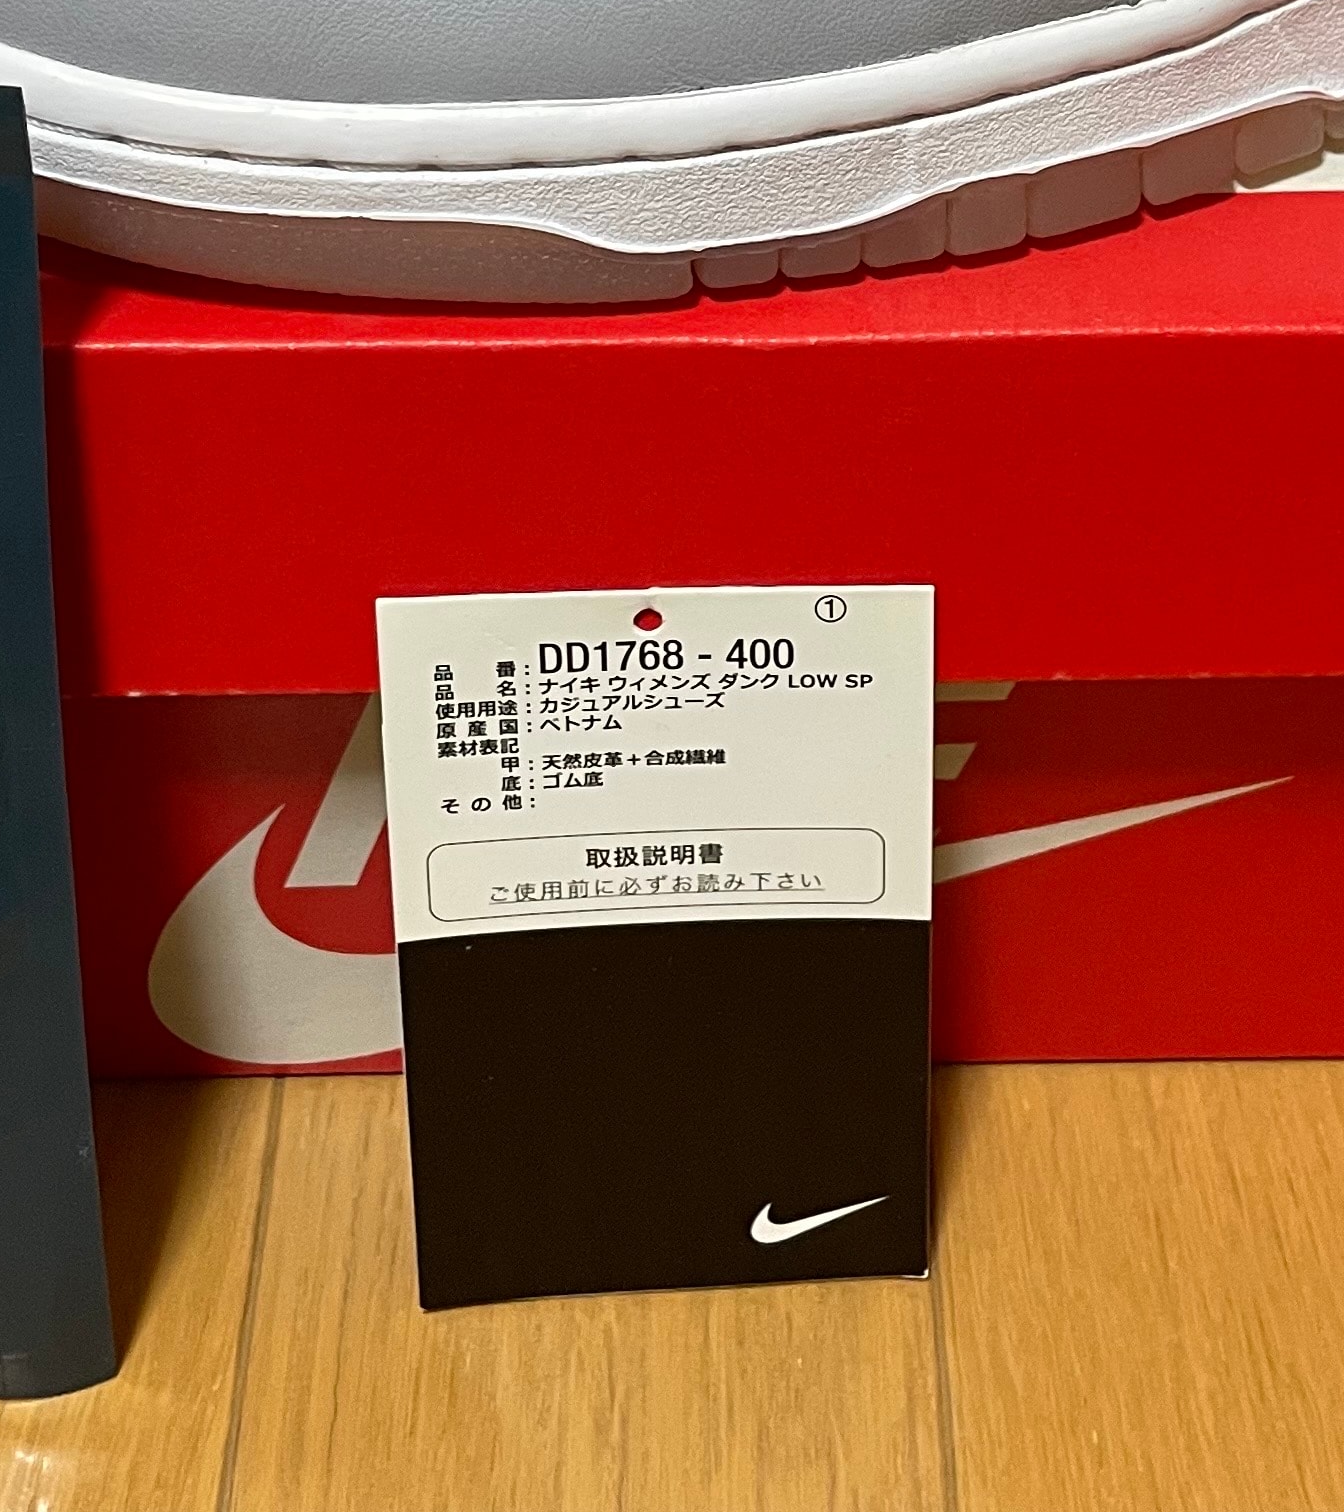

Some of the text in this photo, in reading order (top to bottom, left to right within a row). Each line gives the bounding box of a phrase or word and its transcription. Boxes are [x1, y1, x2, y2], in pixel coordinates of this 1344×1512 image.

[539, 639, 684, 674] DD1768
[725, 638, 795, 669] 400
[538, 677, 600, 695] ナイキ
[718, 673, 779, 690] ダンク
[789, 674, 837, 688] LOW
[845, 674, 873, 688] SP
[540, 691, 726, 714] カジュアルシューズ
[540, 715, 623, 732] ベトナム
[437, 738, 519, 758] 素材表記
[543, 772, 604, 789] ゴム底
[586, 843, 724, 868] 取扱説明書
[489, 873, 823, 901] ご使用前に必ずお読み下さい
